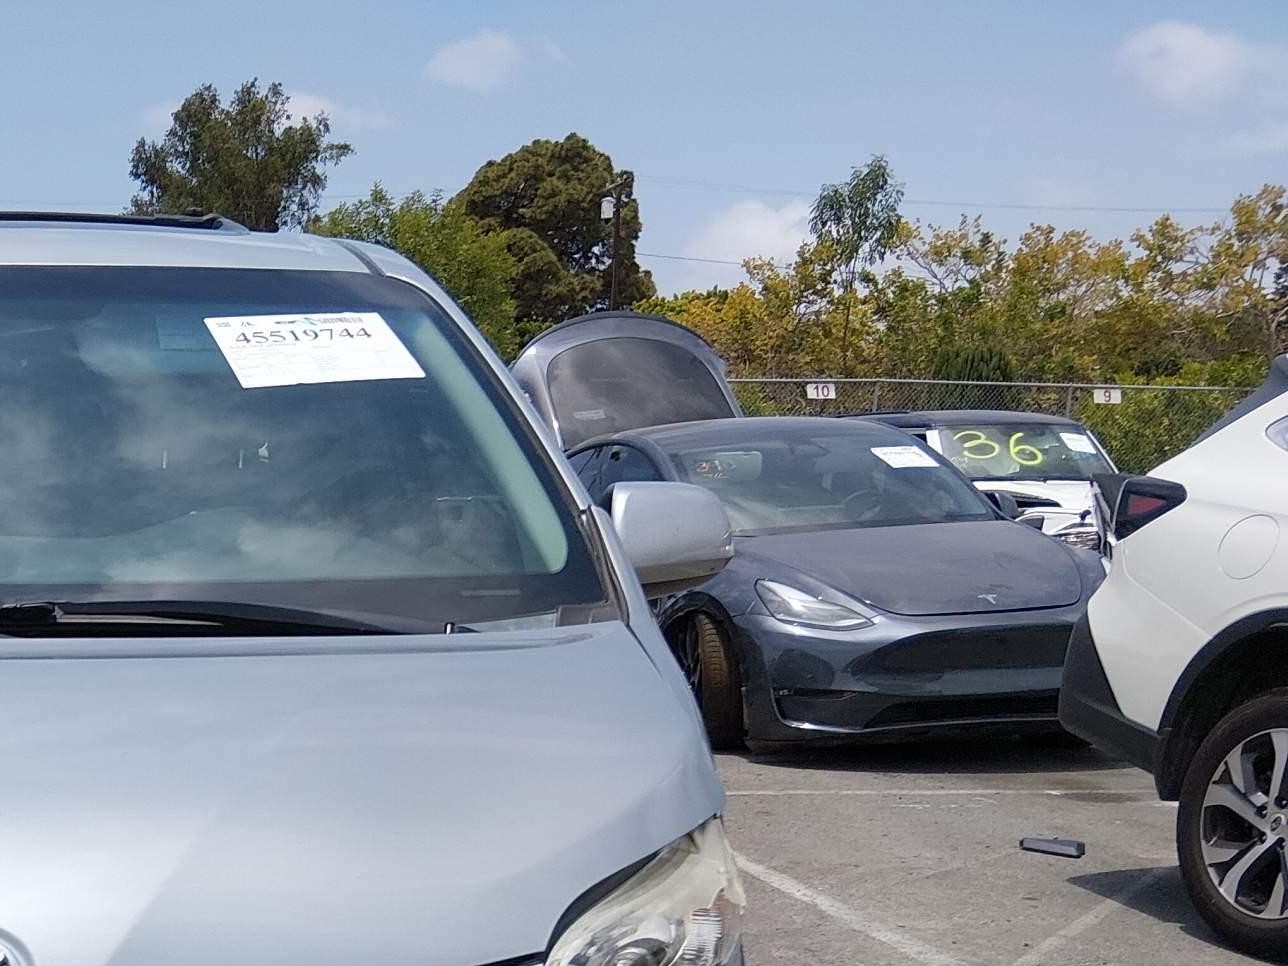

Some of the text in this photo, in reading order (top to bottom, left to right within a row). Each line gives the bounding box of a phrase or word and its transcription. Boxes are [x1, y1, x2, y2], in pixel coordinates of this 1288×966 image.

[235, 327, 372, 344] 45519744
[813, 385, 829, 398] 10
[1103, 390, 1112, 403] 9
[953, 430, 1044, 465] 36
